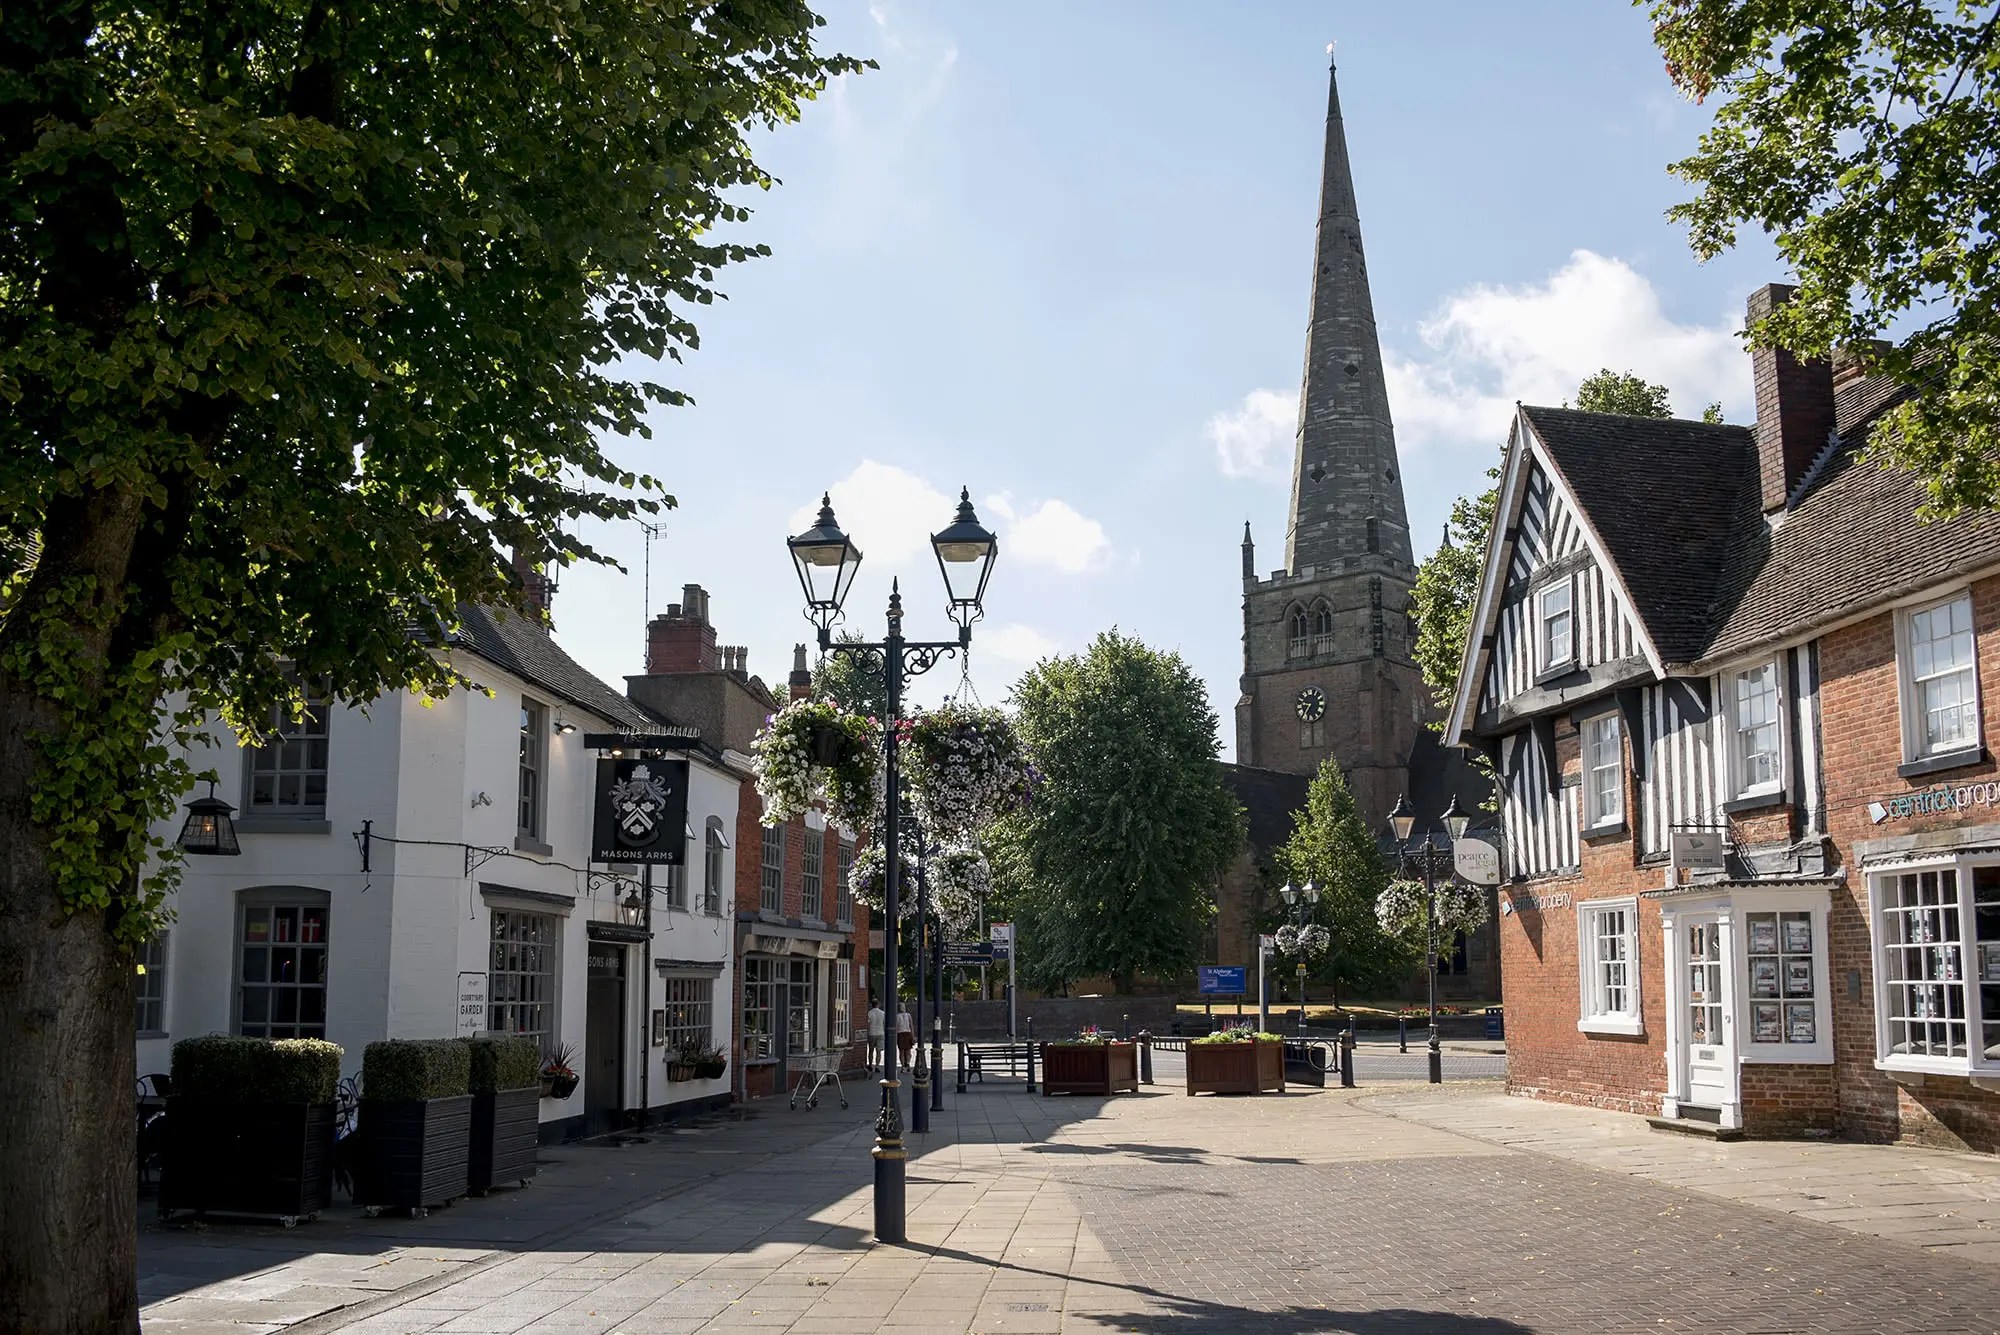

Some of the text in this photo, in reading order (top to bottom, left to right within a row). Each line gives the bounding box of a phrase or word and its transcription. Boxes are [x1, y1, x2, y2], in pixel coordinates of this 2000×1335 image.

[1889, 782, 2000, 816] centrickprop
[601, 850, 673, 860] MASONS ARMS
[460, 1004, 484, 1015] GARDEN
